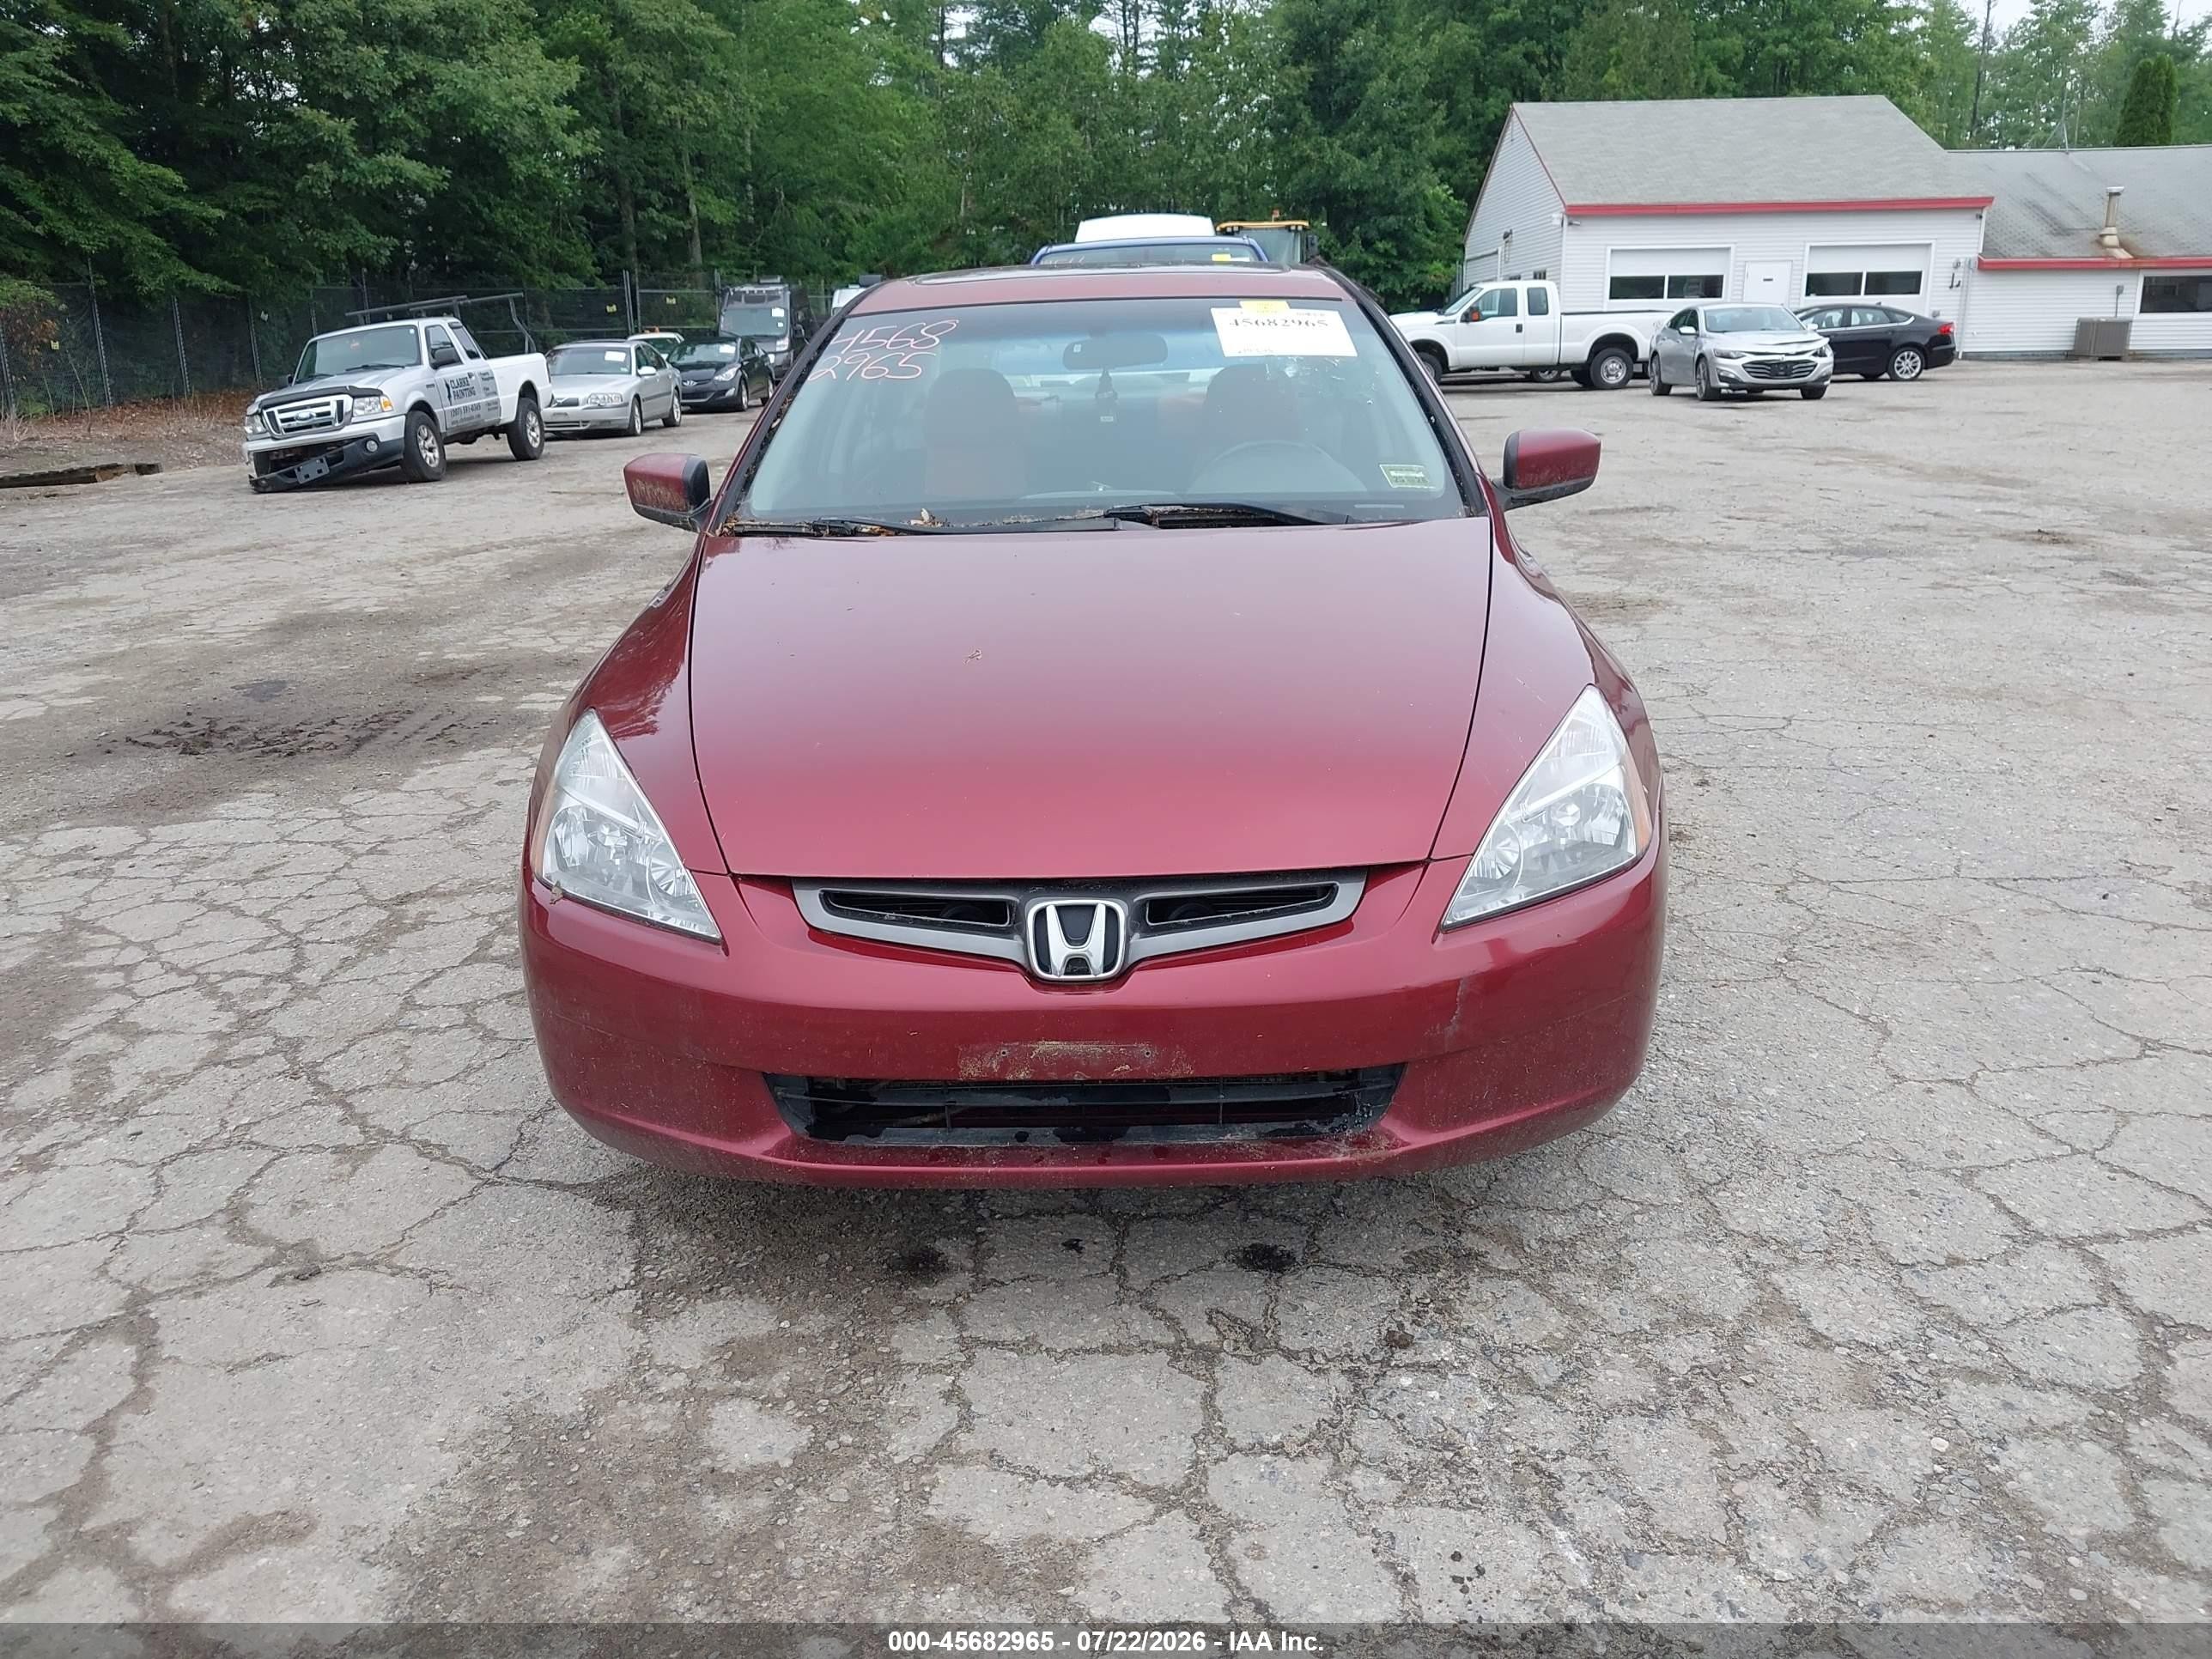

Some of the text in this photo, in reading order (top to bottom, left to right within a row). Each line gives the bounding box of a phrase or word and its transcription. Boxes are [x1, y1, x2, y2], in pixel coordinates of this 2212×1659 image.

[1230, 319, 1328, 327] 45682965
[830, 319, 960, 354] 4568
[807, 352, 936, 380] 2965
[453, 386, 477, 400] PAINTING
